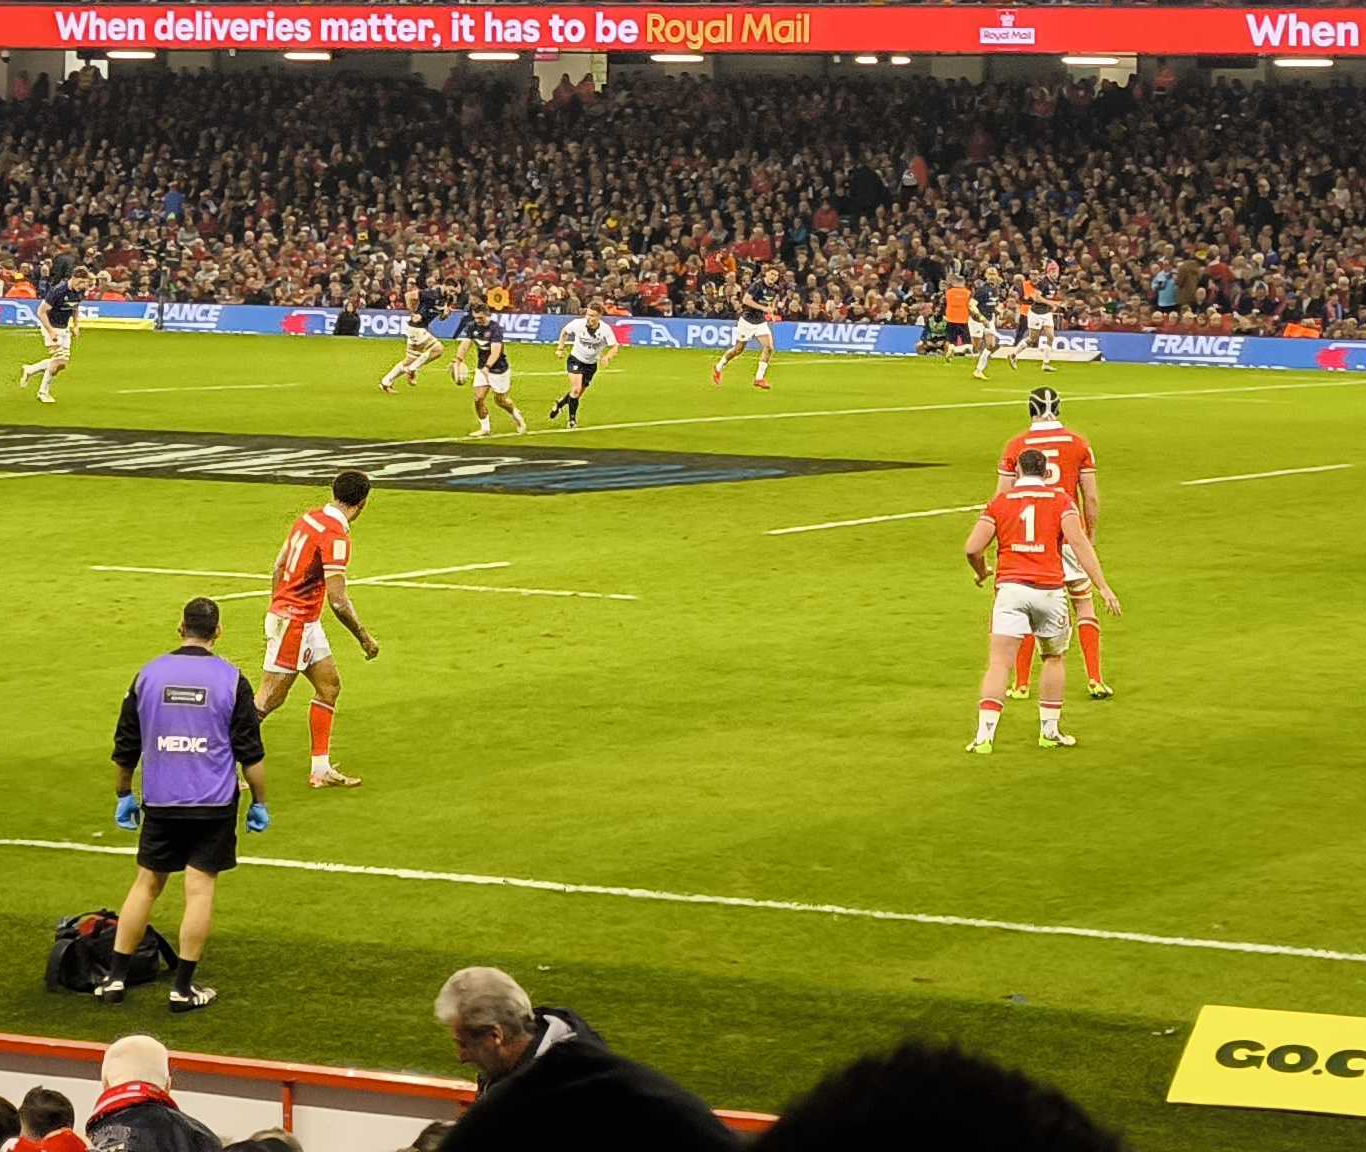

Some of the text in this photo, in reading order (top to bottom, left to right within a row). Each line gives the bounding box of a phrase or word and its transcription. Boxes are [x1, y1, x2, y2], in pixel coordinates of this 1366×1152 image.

[55, 11, 810, 50] When deliveries matter, it has to be Royal Mail
[983, 29, 1032, 41] Royal Mail
[1245, 13, 1359, 48] When
[793, 323, 882, 343] FRANCE
[1151, 335, 1245, 356] FRANCE
[1042, 449, 1061, 485] 5
[1020, 504, 1035, 542] 1
[283, 529, 309, 582] 11
[157, 735, 208, 753] MEDIC
